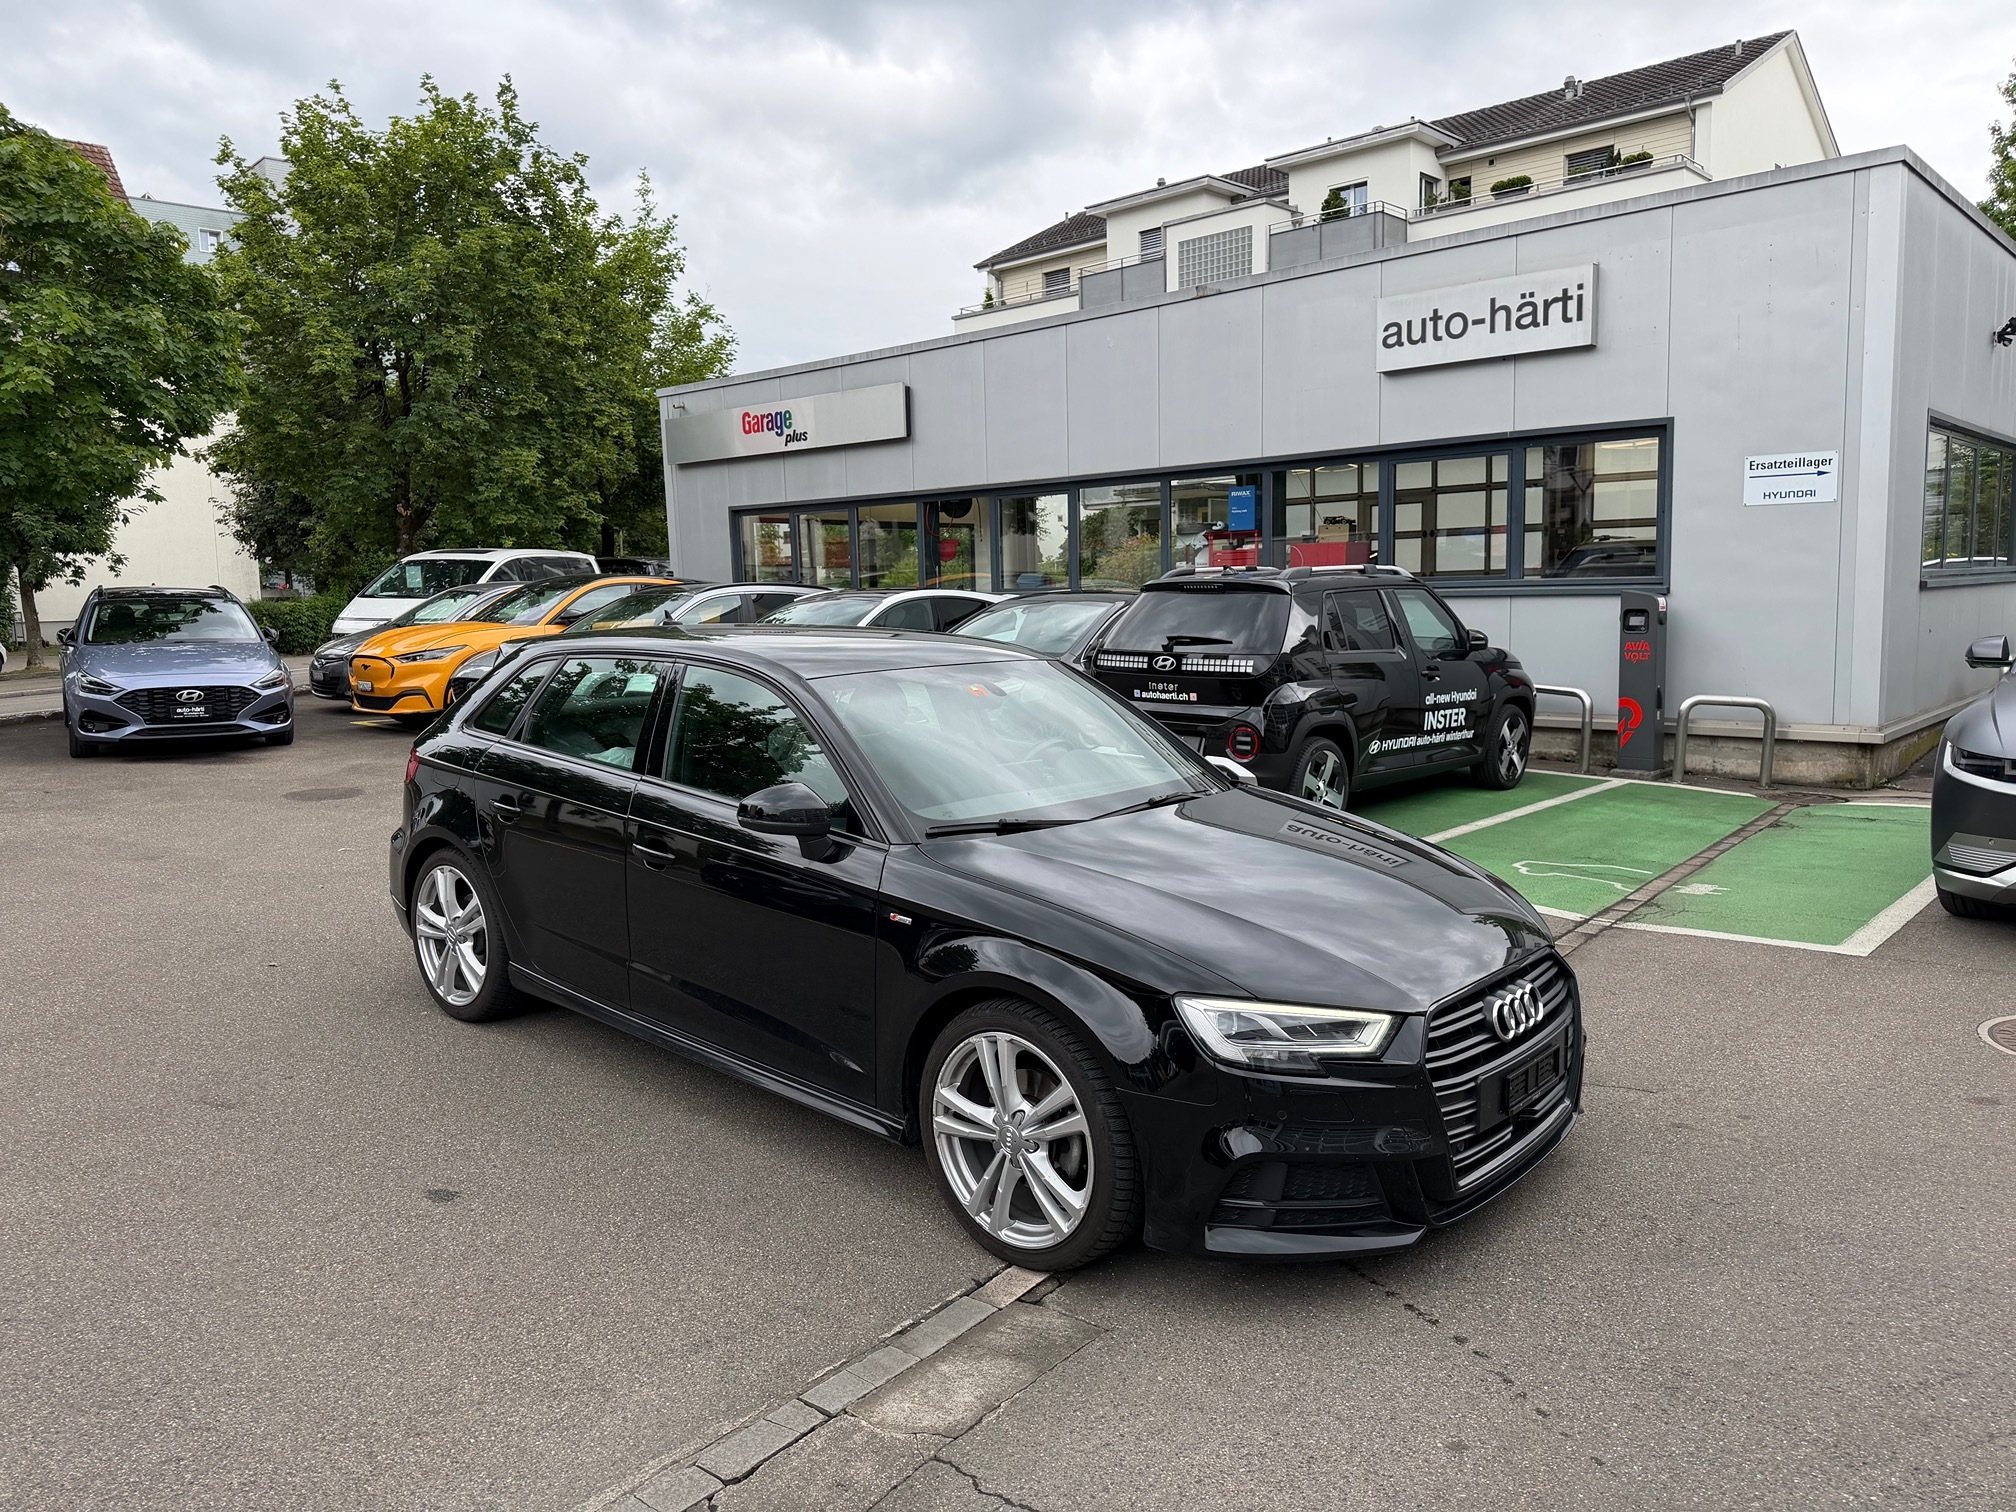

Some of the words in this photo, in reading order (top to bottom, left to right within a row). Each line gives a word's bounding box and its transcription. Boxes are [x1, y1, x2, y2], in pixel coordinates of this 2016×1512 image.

[1381, 283, 1585, 350] auto-härti
[742, 409, 793, 437] Garage
[784, 429, 809, 447] plus
[1749, 457, 1834, 471] Ersatzteillager
[1231, 489, 1252, 498] RIWAX
[1763, 489, 1817, 500] HYUNDAI
[1624, 640, 1651, 651] AVIA
[1624, 652, 1651, 664] VOLT
[1141, 691, 1189, 701] autohaerti.ch
[1425, 692, 1451, 705] all-new
[1451, 688, 1478, 705] Hyundai
[1423, 707, 1467, 731] INSTER
[1381, 736, 1417, 752] HYUNDAI
[1416, 732, 1446, 746] auto-härti
[1445, 729, 1475, 742] winterthur
